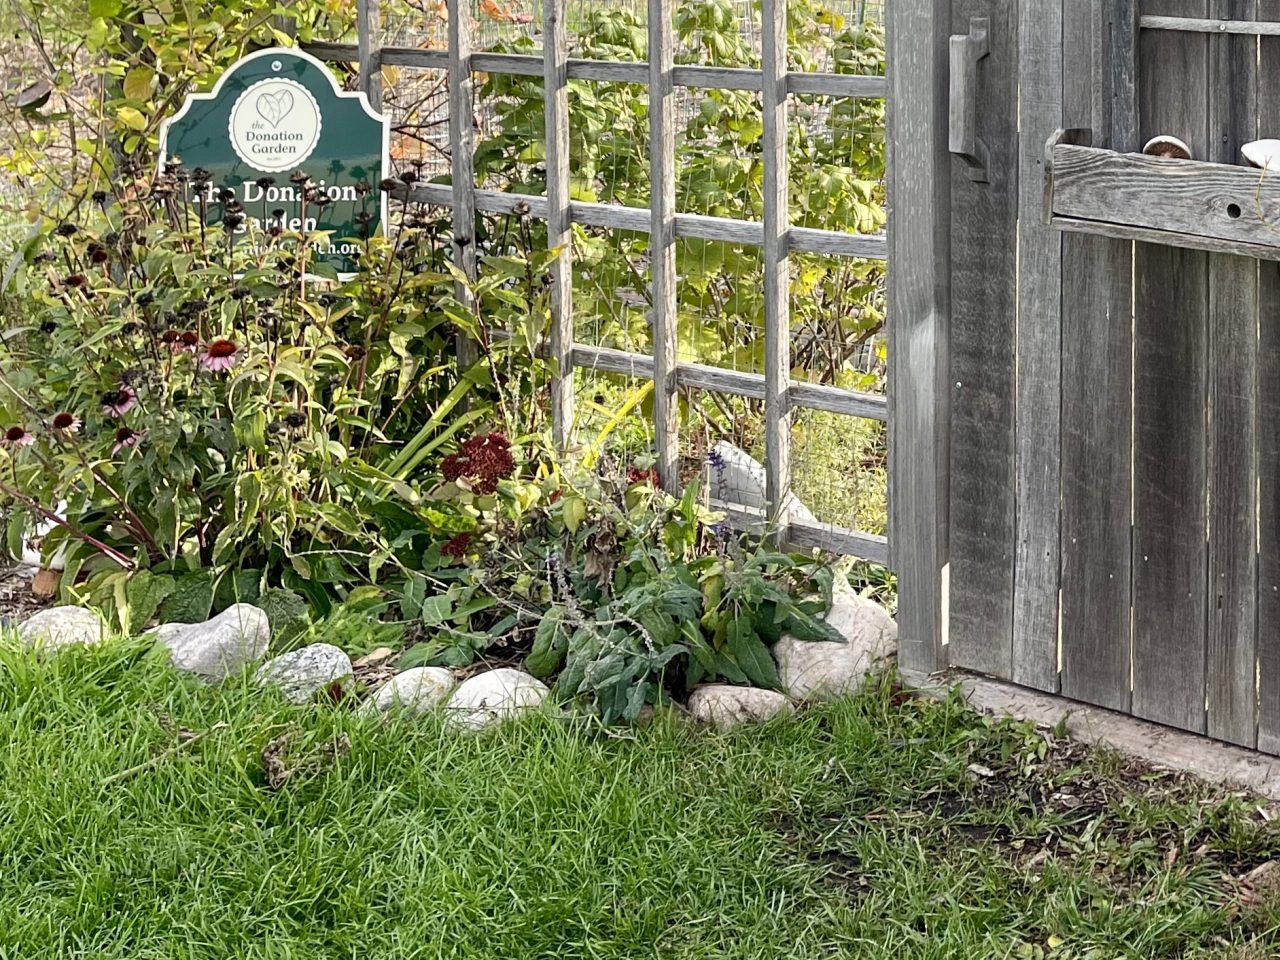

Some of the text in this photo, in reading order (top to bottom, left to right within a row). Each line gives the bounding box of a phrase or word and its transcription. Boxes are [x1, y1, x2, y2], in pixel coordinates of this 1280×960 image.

[251, 120, 264, 130] the
[246, 131, 303, 141] Donation
[251, 142, 297, 153] Garden
